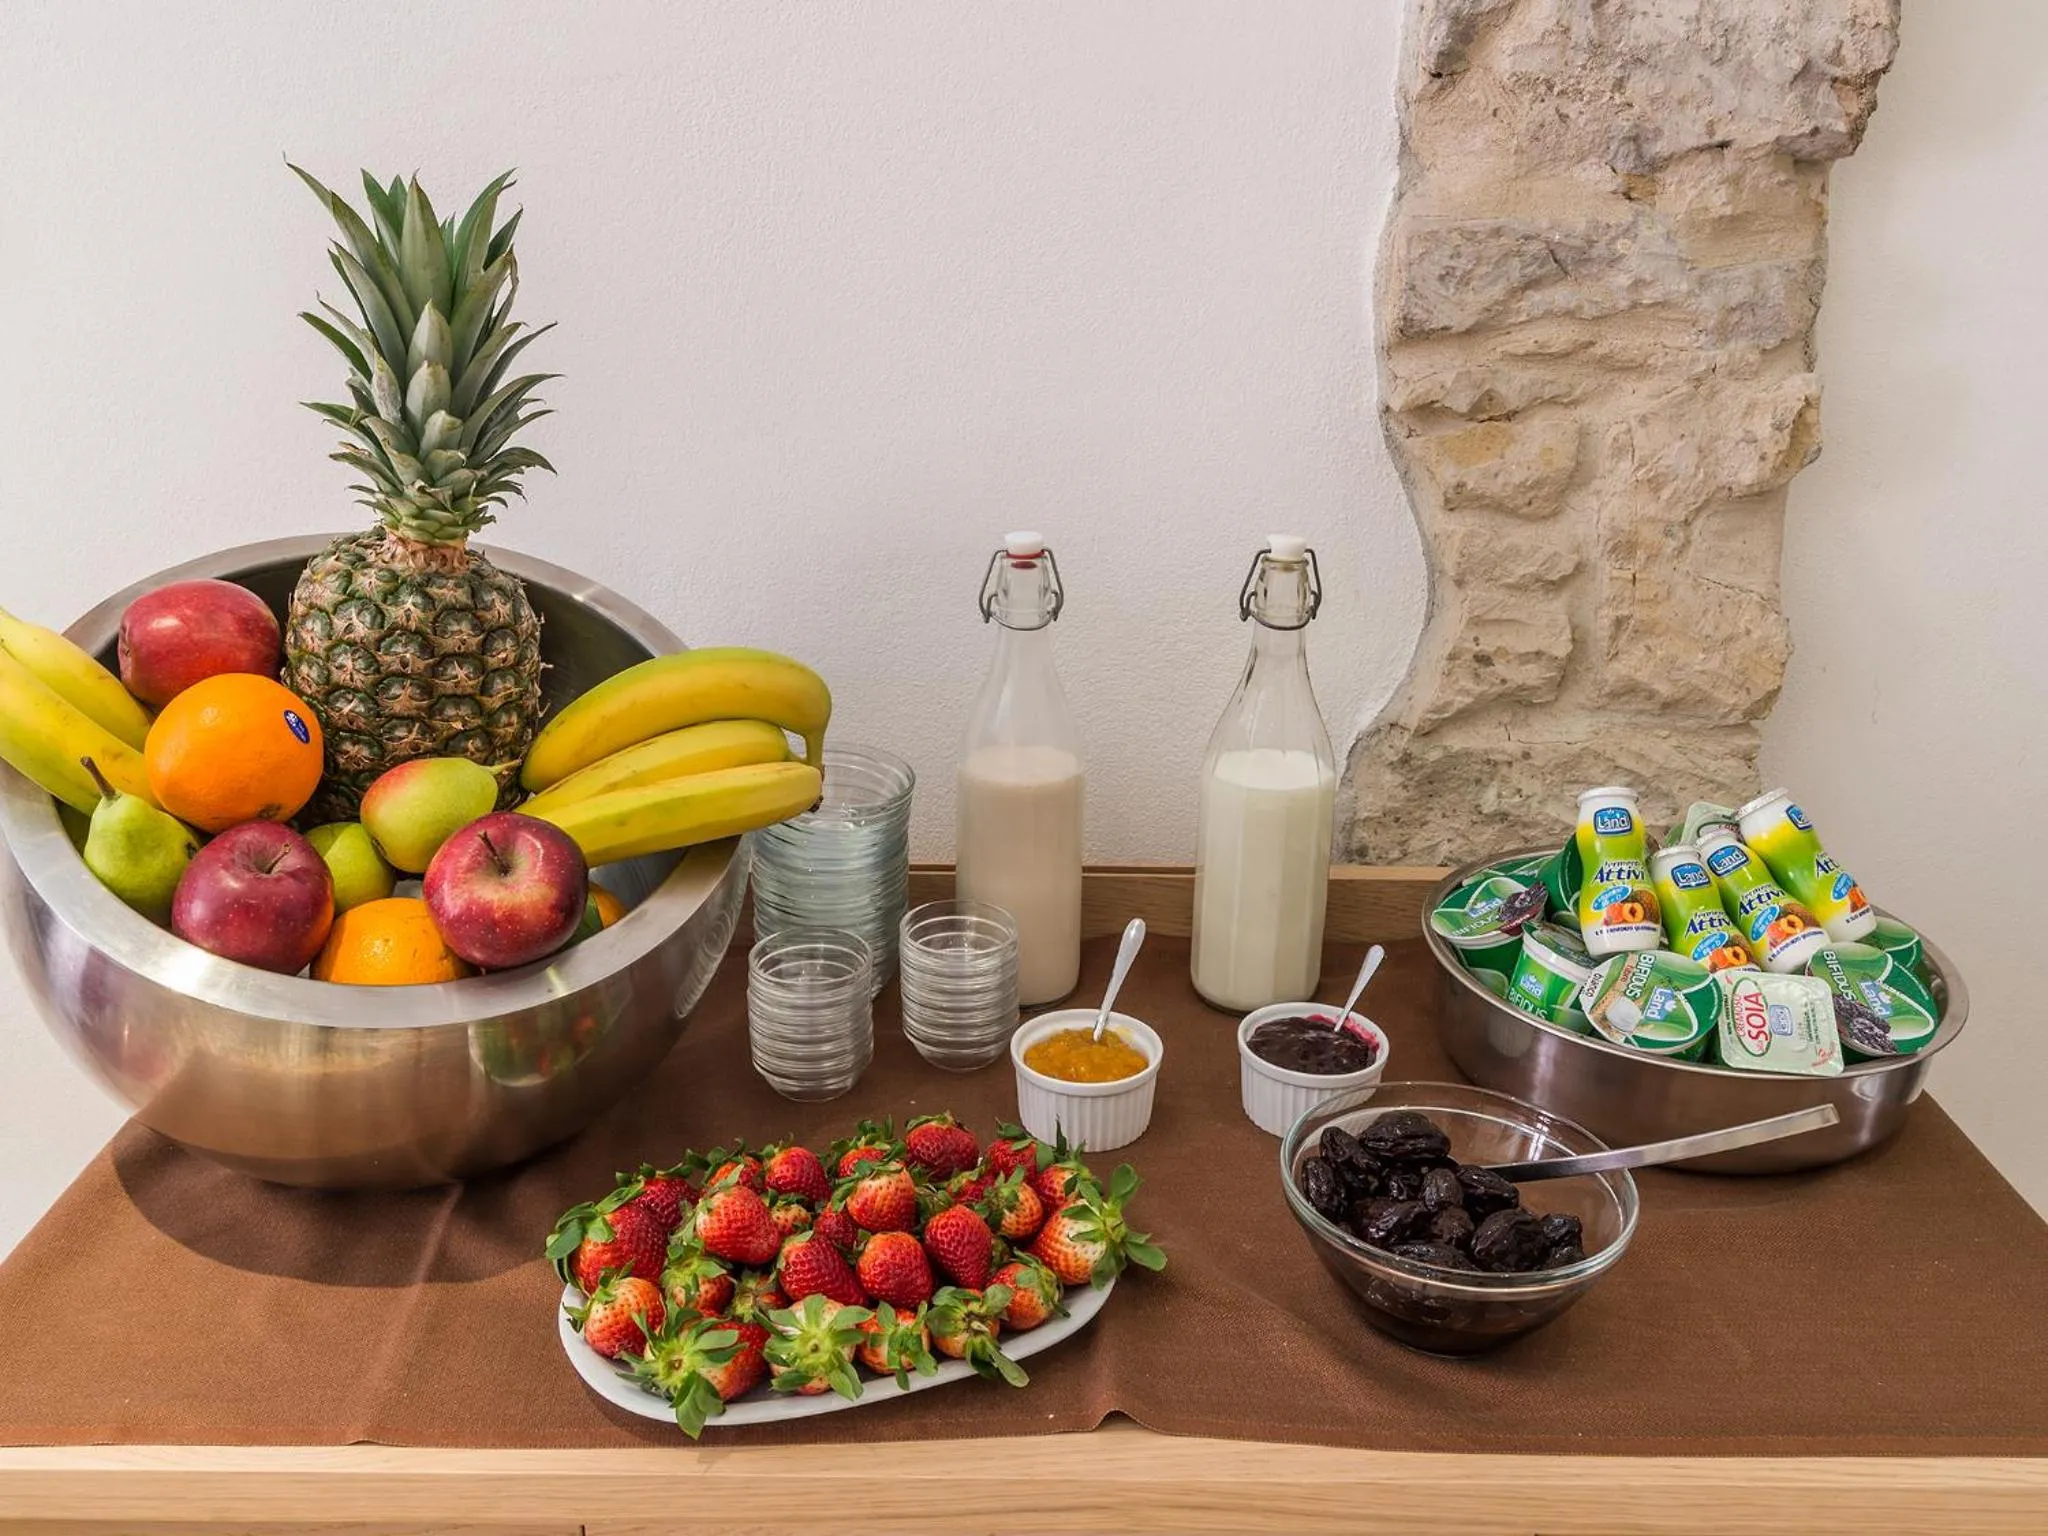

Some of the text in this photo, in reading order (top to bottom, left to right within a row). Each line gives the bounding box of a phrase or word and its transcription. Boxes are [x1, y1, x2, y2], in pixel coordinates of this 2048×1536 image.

[1598, 814, 1629, 829] Land
[1676, 871, 1706, 883] Land
[1711, 850, 1743, 870] Land
[1625, 953, 1656, 999] BIFIDUS
[1823, 950, 1857, 1002] BIFIDUS
[1646, 987, 1673, 1020] Land
[1860, 981, 1891, 1017] Land
[1743, 992, 1769, 1041] SOIA
